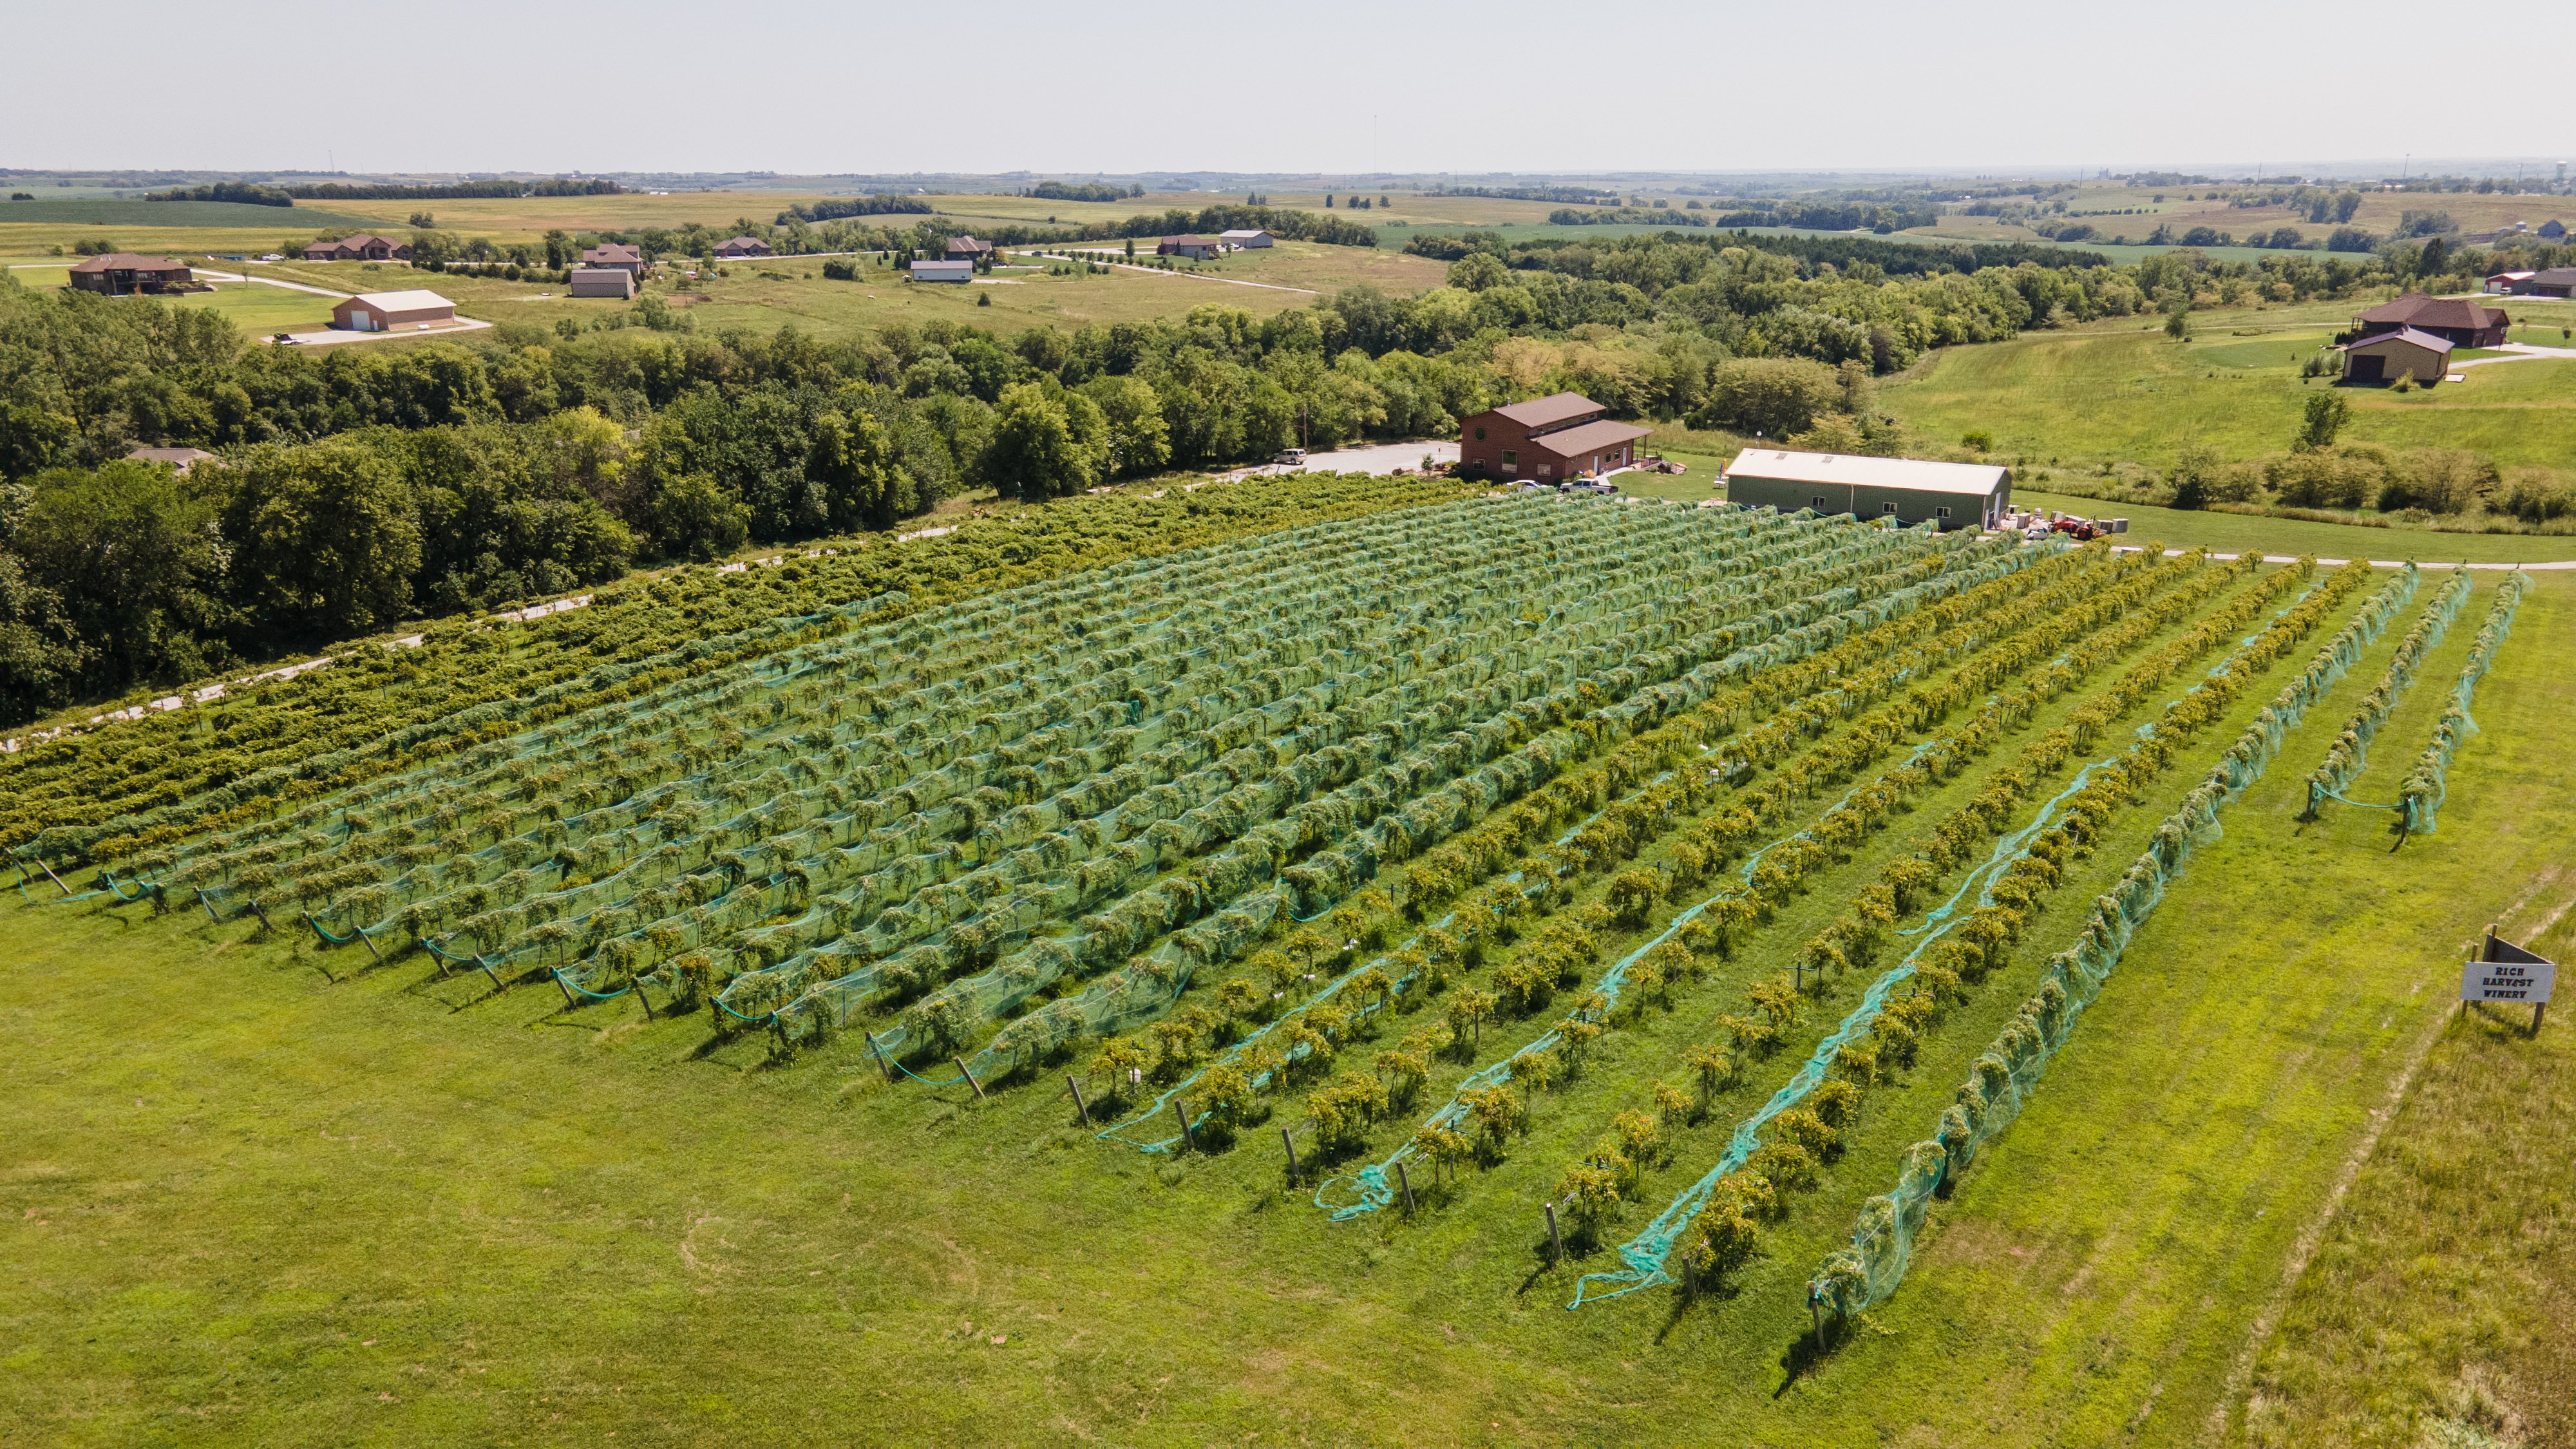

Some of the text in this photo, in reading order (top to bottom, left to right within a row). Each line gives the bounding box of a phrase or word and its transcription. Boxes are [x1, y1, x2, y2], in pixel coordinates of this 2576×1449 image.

[2496, 967, 2524, 976] RICH
[2483, 978, 2534, 987] HARVEST
[2484, 990, 2527, 998] WINERY
